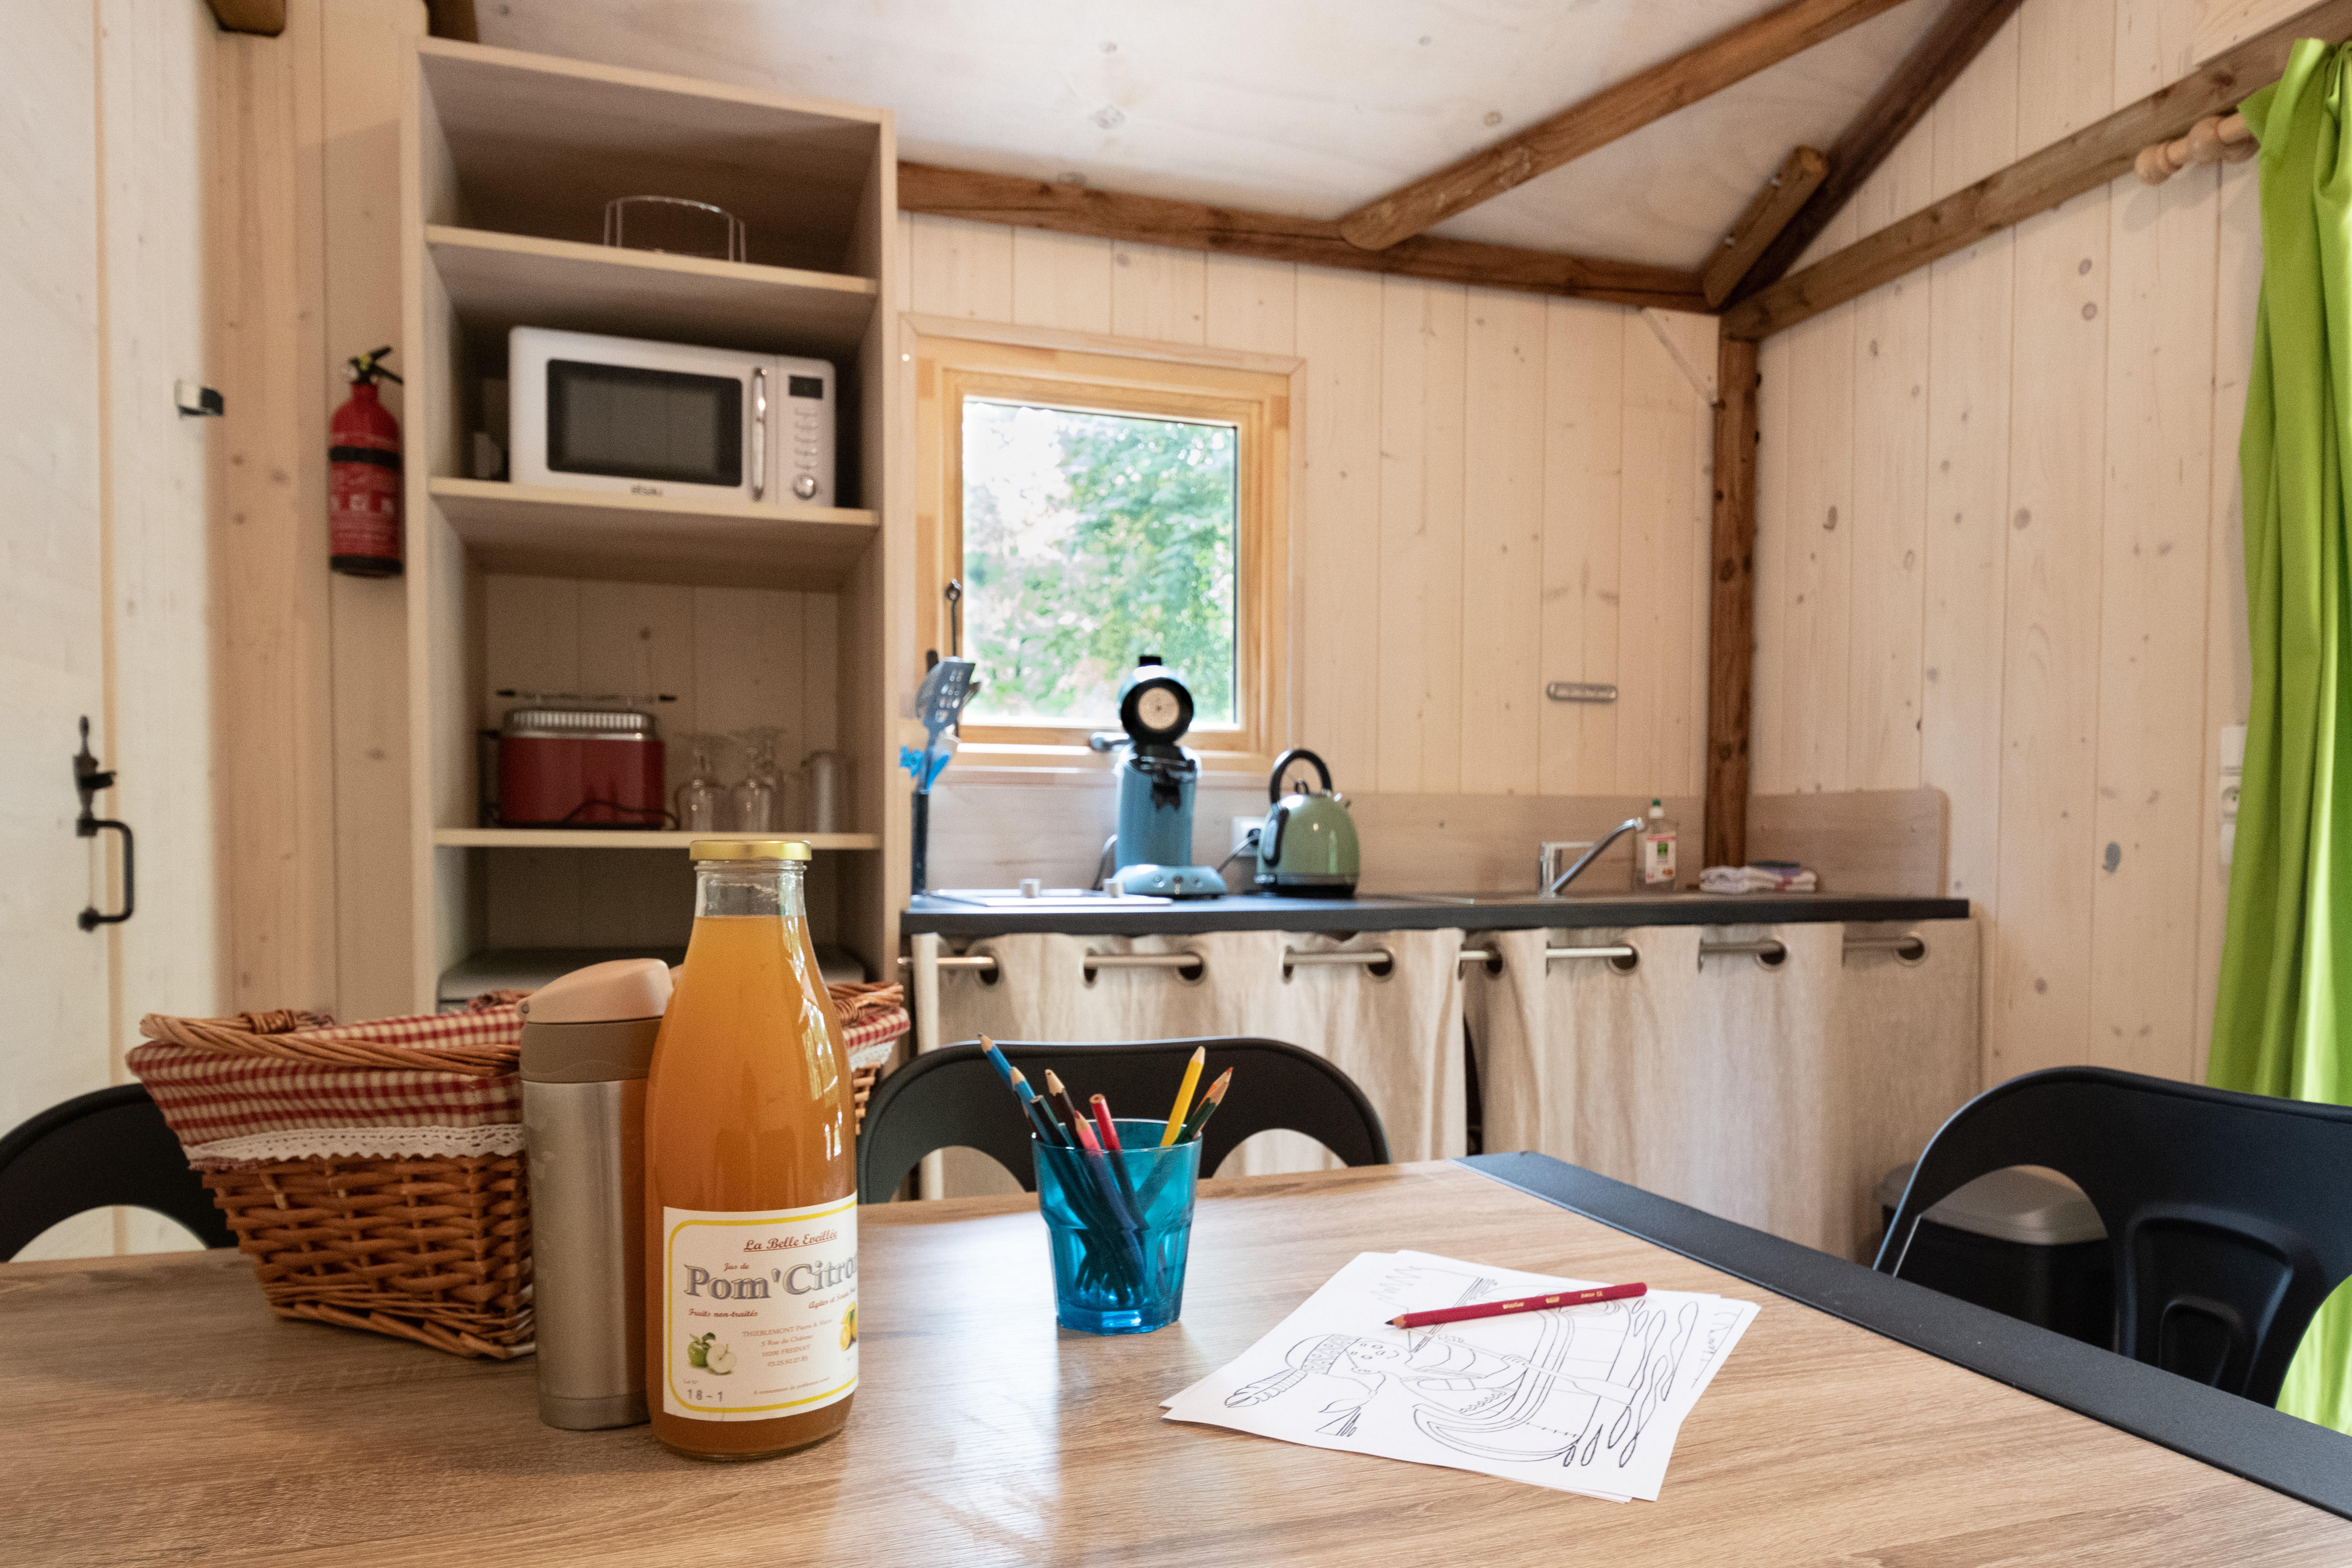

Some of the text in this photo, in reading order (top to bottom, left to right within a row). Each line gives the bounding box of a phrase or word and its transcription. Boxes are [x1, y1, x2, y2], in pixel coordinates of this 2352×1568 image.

[744, 1229, 837, 1250] La Belle Eveillée
[723, 1263, 738, 1272] Jus
[688, 1308, 711, 1317] Fruits
